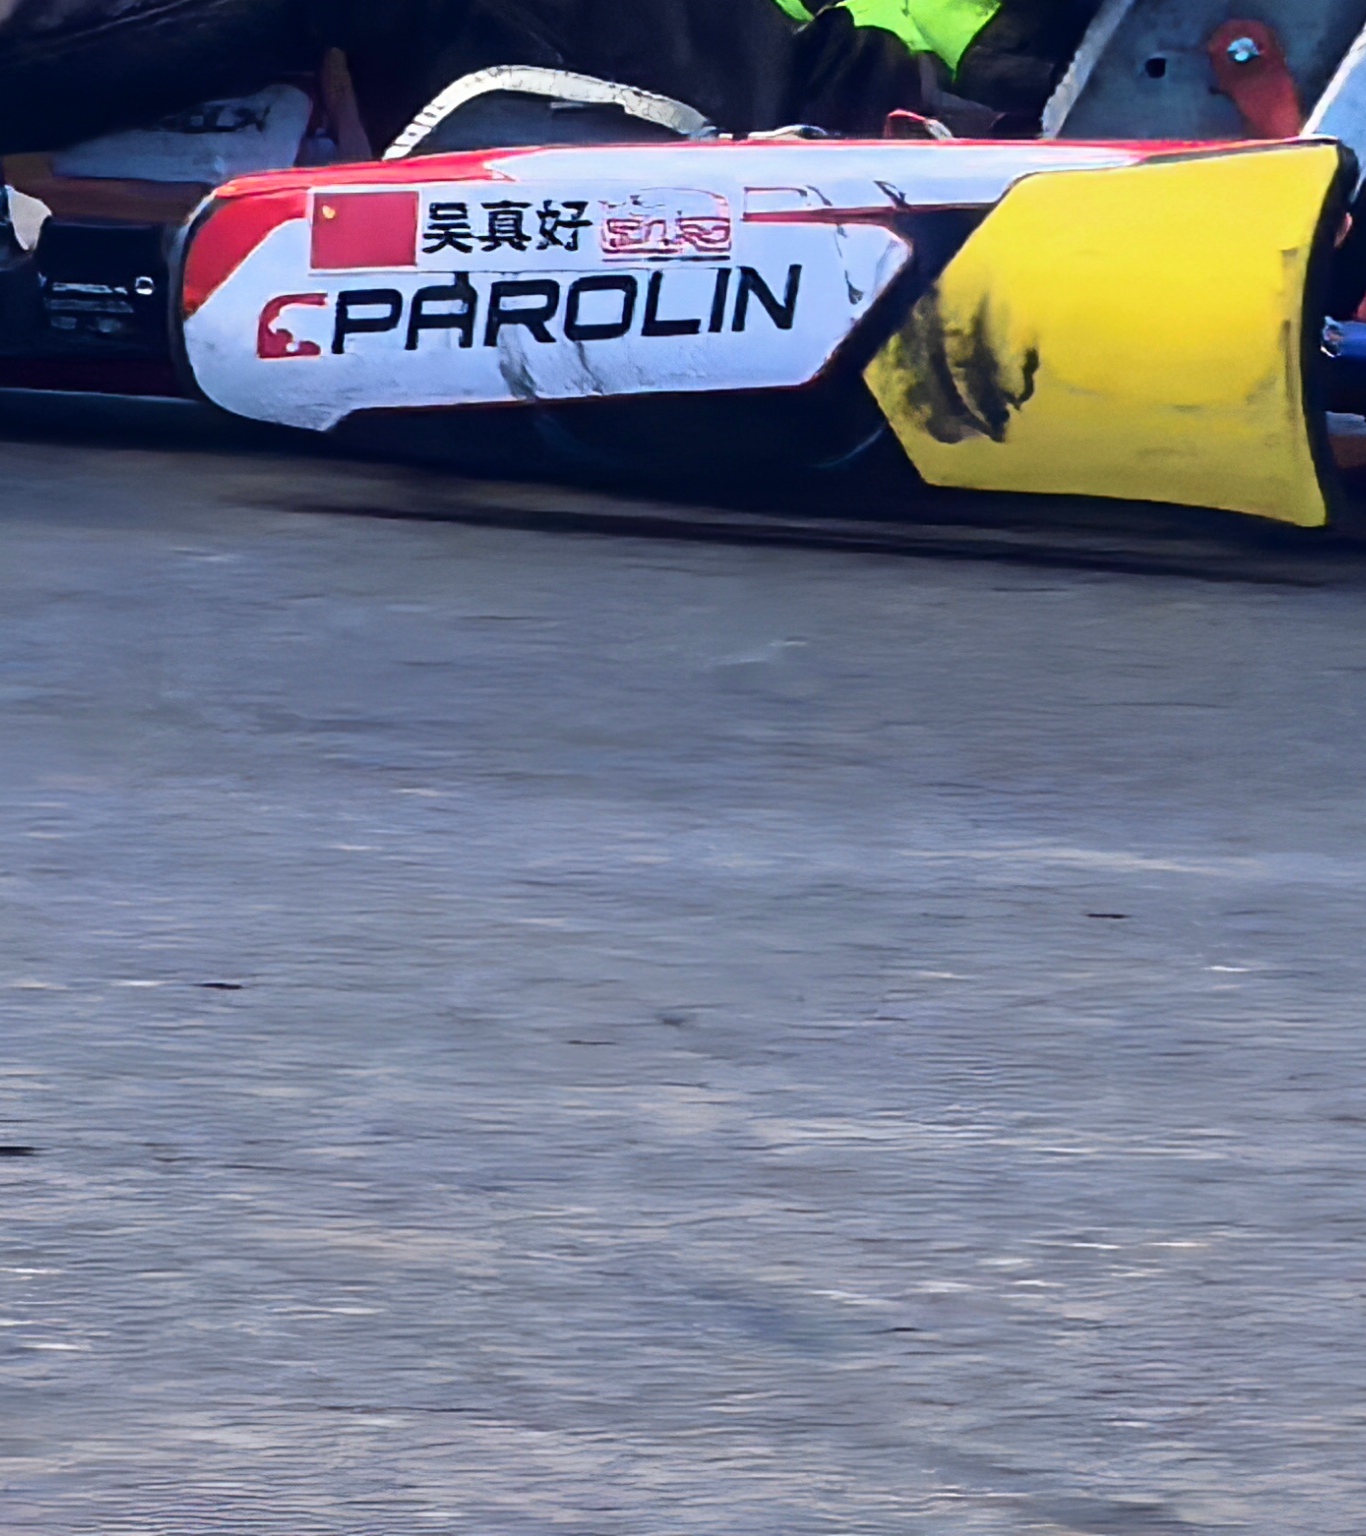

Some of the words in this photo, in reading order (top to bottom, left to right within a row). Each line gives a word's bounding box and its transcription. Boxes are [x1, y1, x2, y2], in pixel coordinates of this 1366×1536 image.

[422, 199, 593, 253] 吴真好
[331, 264, 803, 355] PAROLIN
